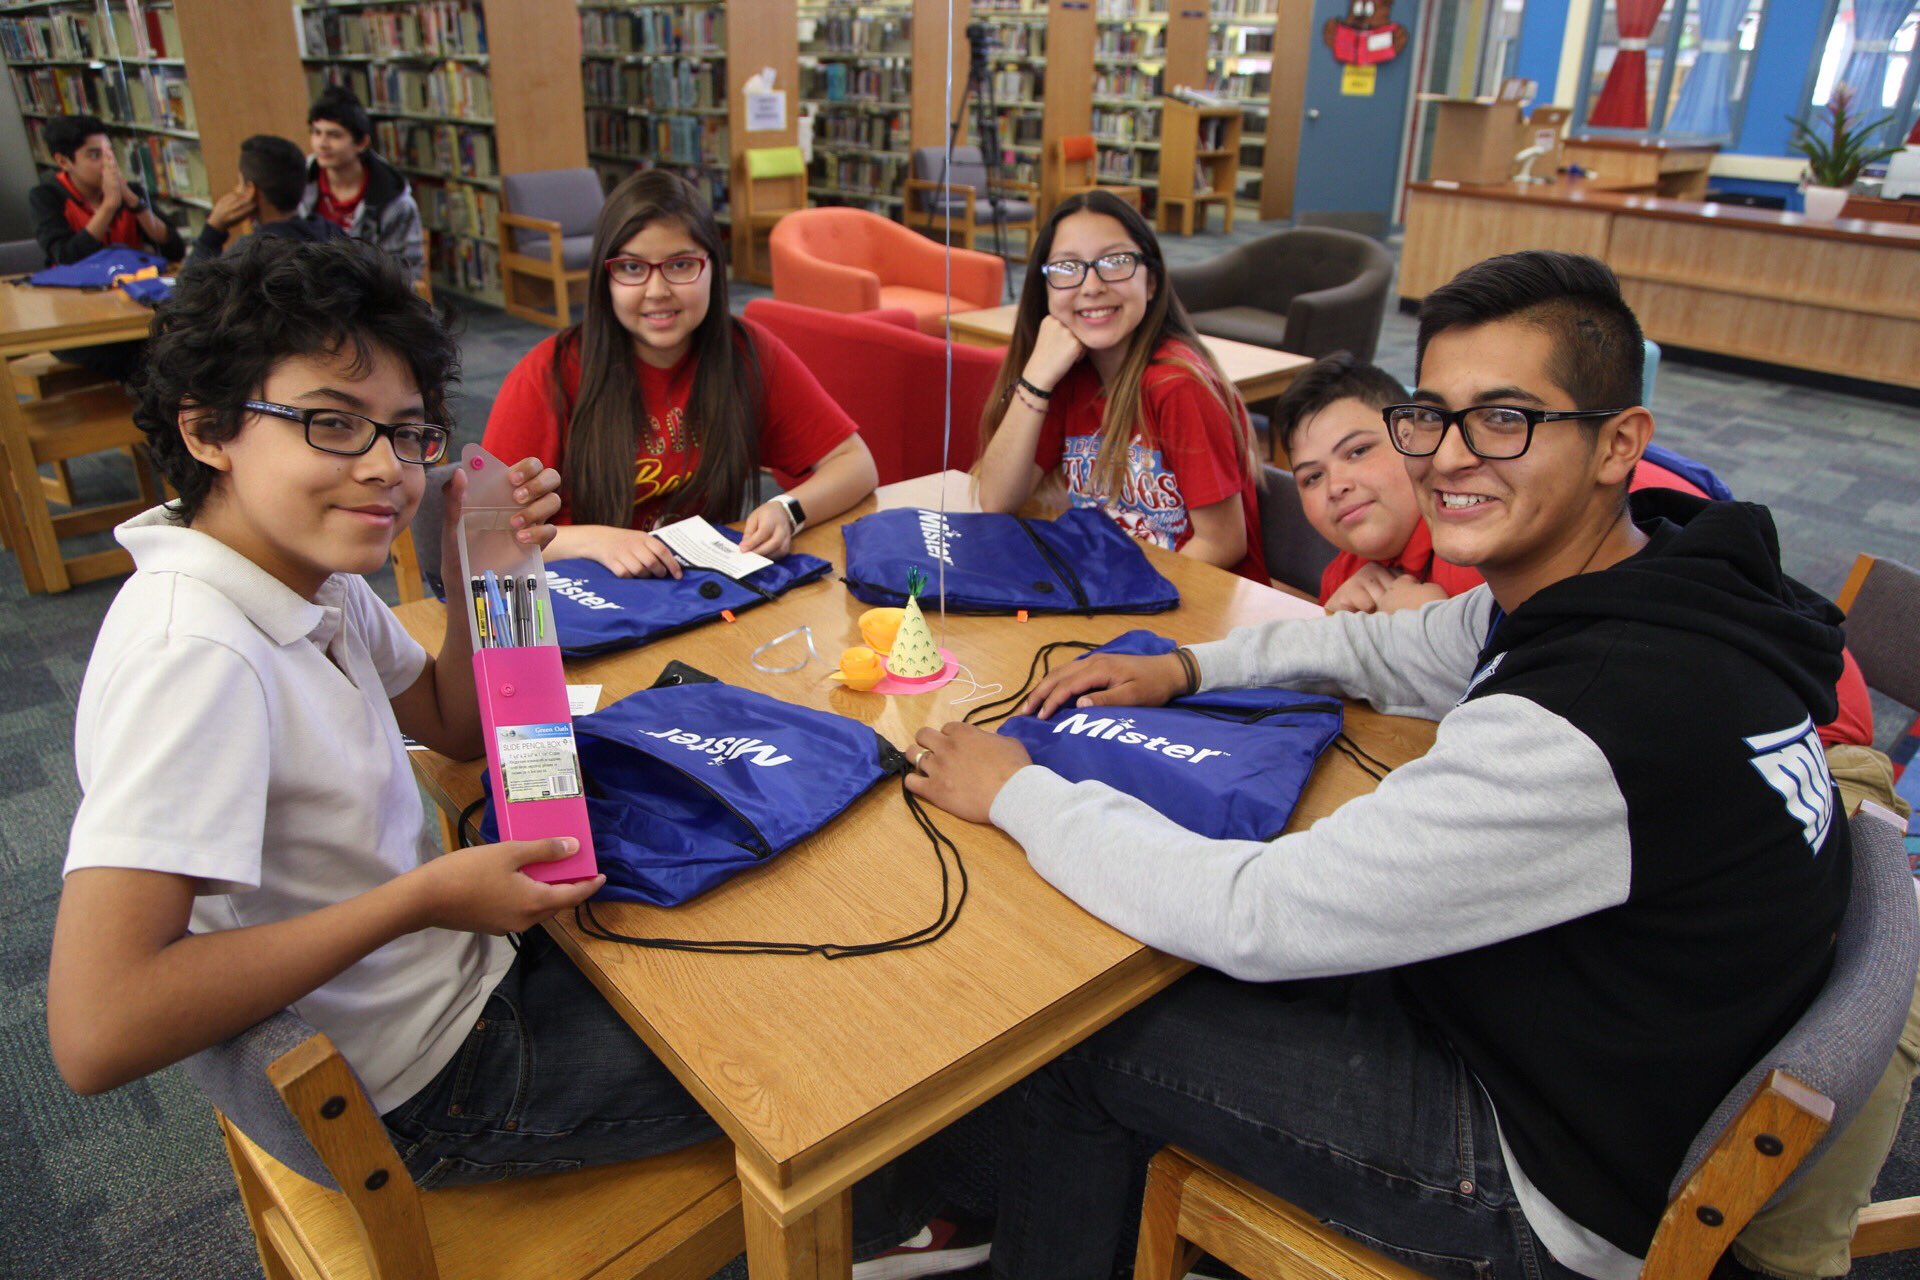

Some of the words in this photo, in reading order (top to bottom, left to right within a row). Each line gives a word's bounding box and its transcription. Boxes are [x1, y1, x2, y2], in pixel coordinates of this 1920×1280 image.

[503, 743, 520, 751] SLIDE
[522, 741, 546, 750] PENCIL
[547, 740, 561, 748] BOX
[644, 728, 793, 767] Mister
[1052, 713, 1222, 764] Mister
